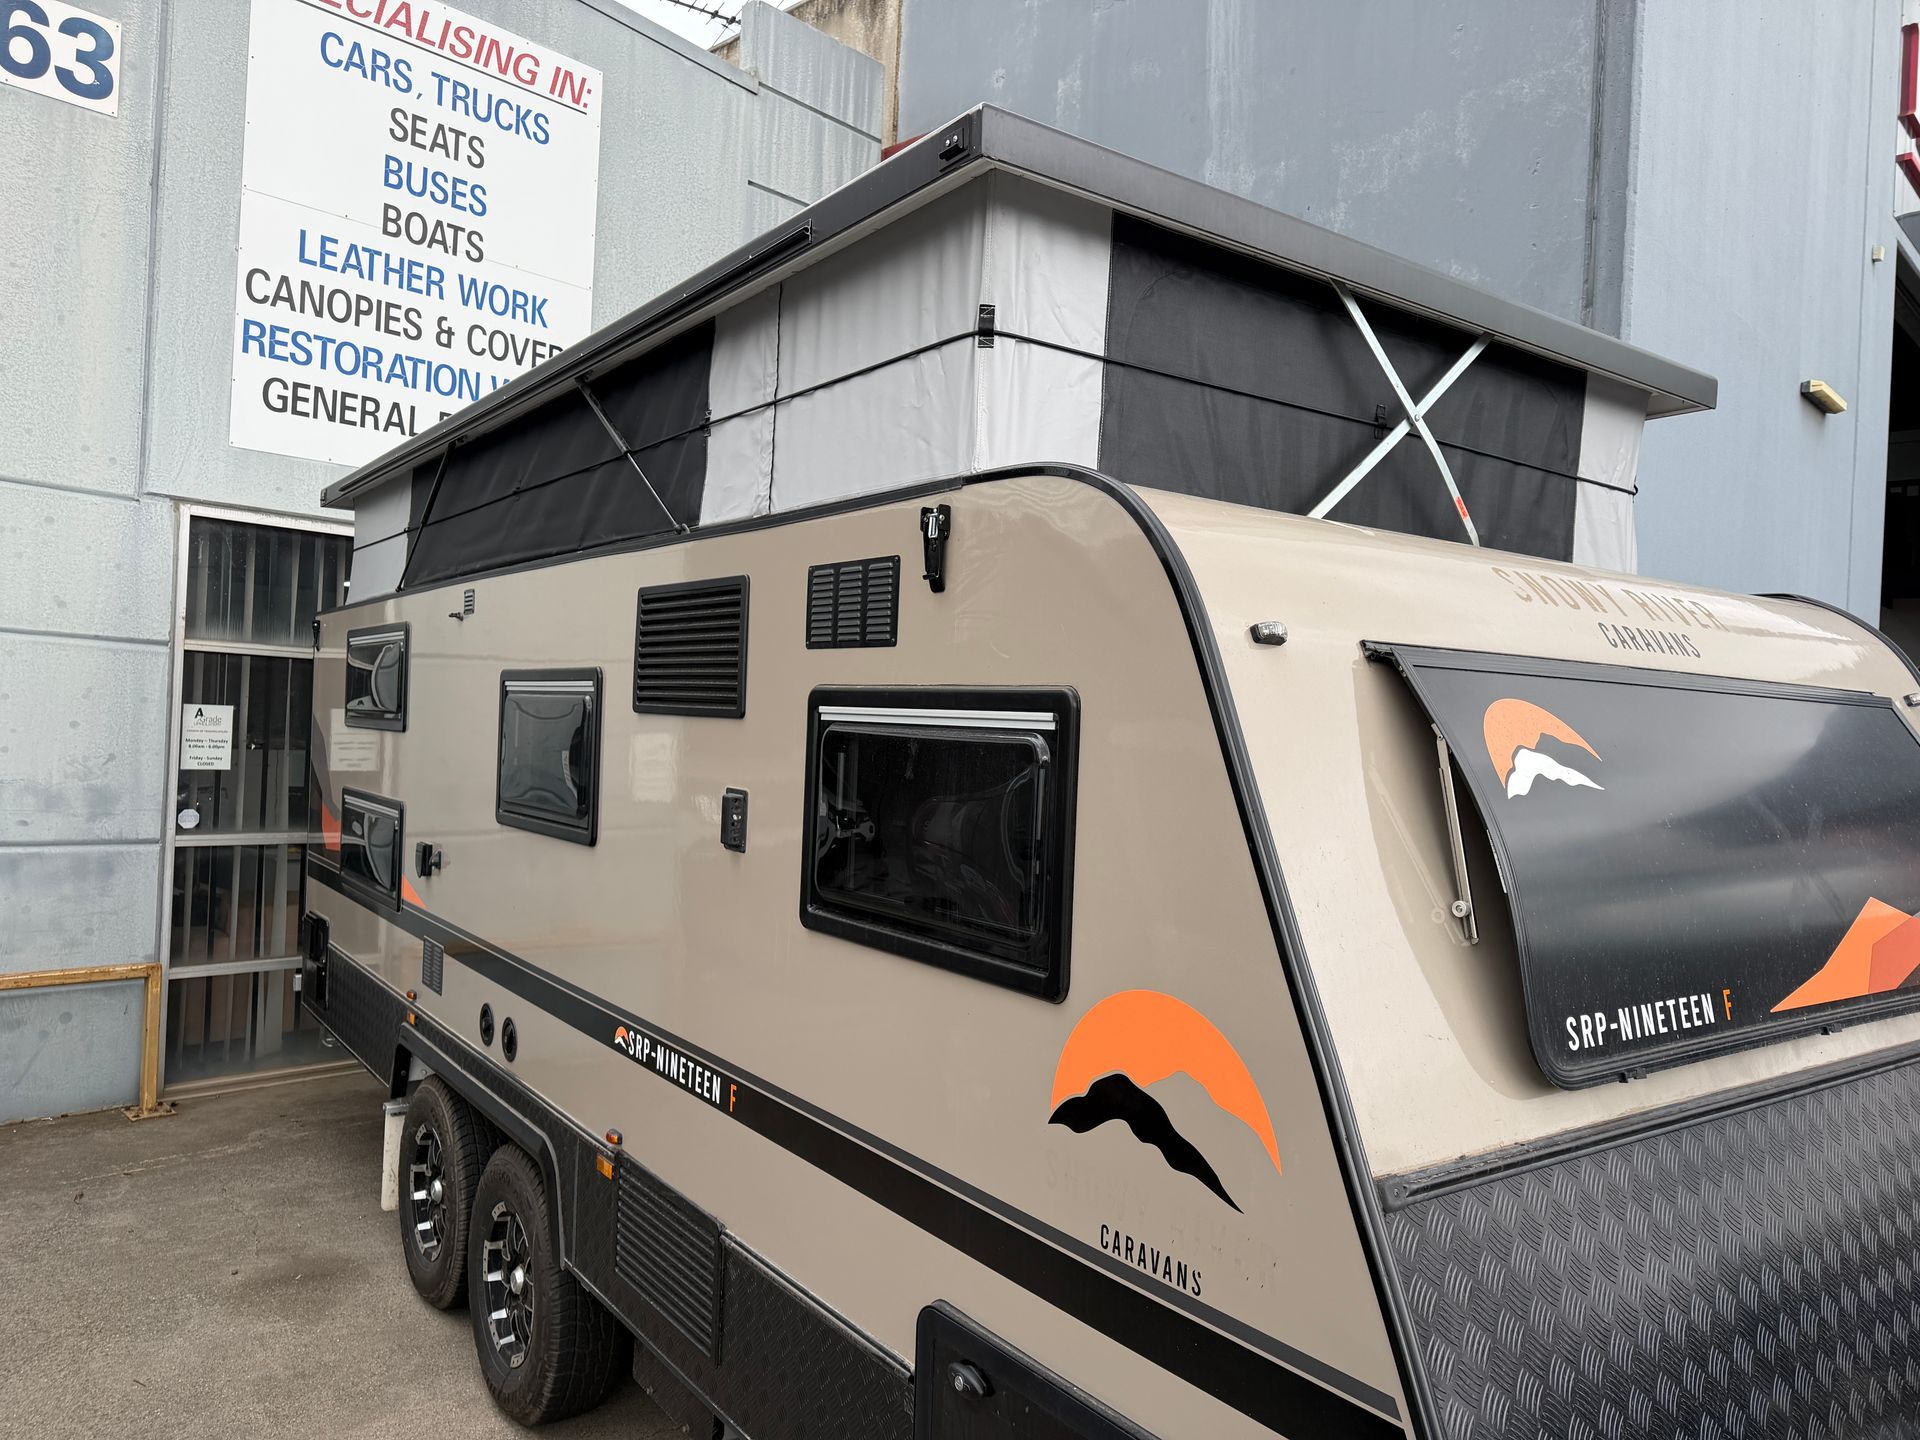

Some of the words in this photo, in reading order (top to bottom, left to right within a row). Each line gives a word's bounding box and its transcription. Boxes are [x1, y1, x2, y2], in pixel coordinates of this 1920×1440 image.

[0, 0, 115, 100] 63
[431, 71, 550, 145] TRUCKS
[549, 66, 593, 109] IN:
[389, 107, 485, 169] SEATS
[383, 154, 487, 217] BUSES
[381, 202, 485, 263] BOATS
[245, 268, 422, 341] CANOPIES
[435, 315, 455, 349] &
[299, 229, 445, 300] LEATHER
[457, 273, 549, 328] WORK
[241, 318, 480, 401] RESTORATION
[262, 377, 420, 438] GENERAL
[1597, 622, 1701, 658] CARAVANS
[1566, 993, 1716, 1051] SRP-NINETEEN
[1722, 989, 1732, 1021] F
[628, 1030, 721, 1104] SRP-NINETEEN
[729, 1083, 737, 1113] F
[1099, 1224, 1202, 1297] CARAVANS
